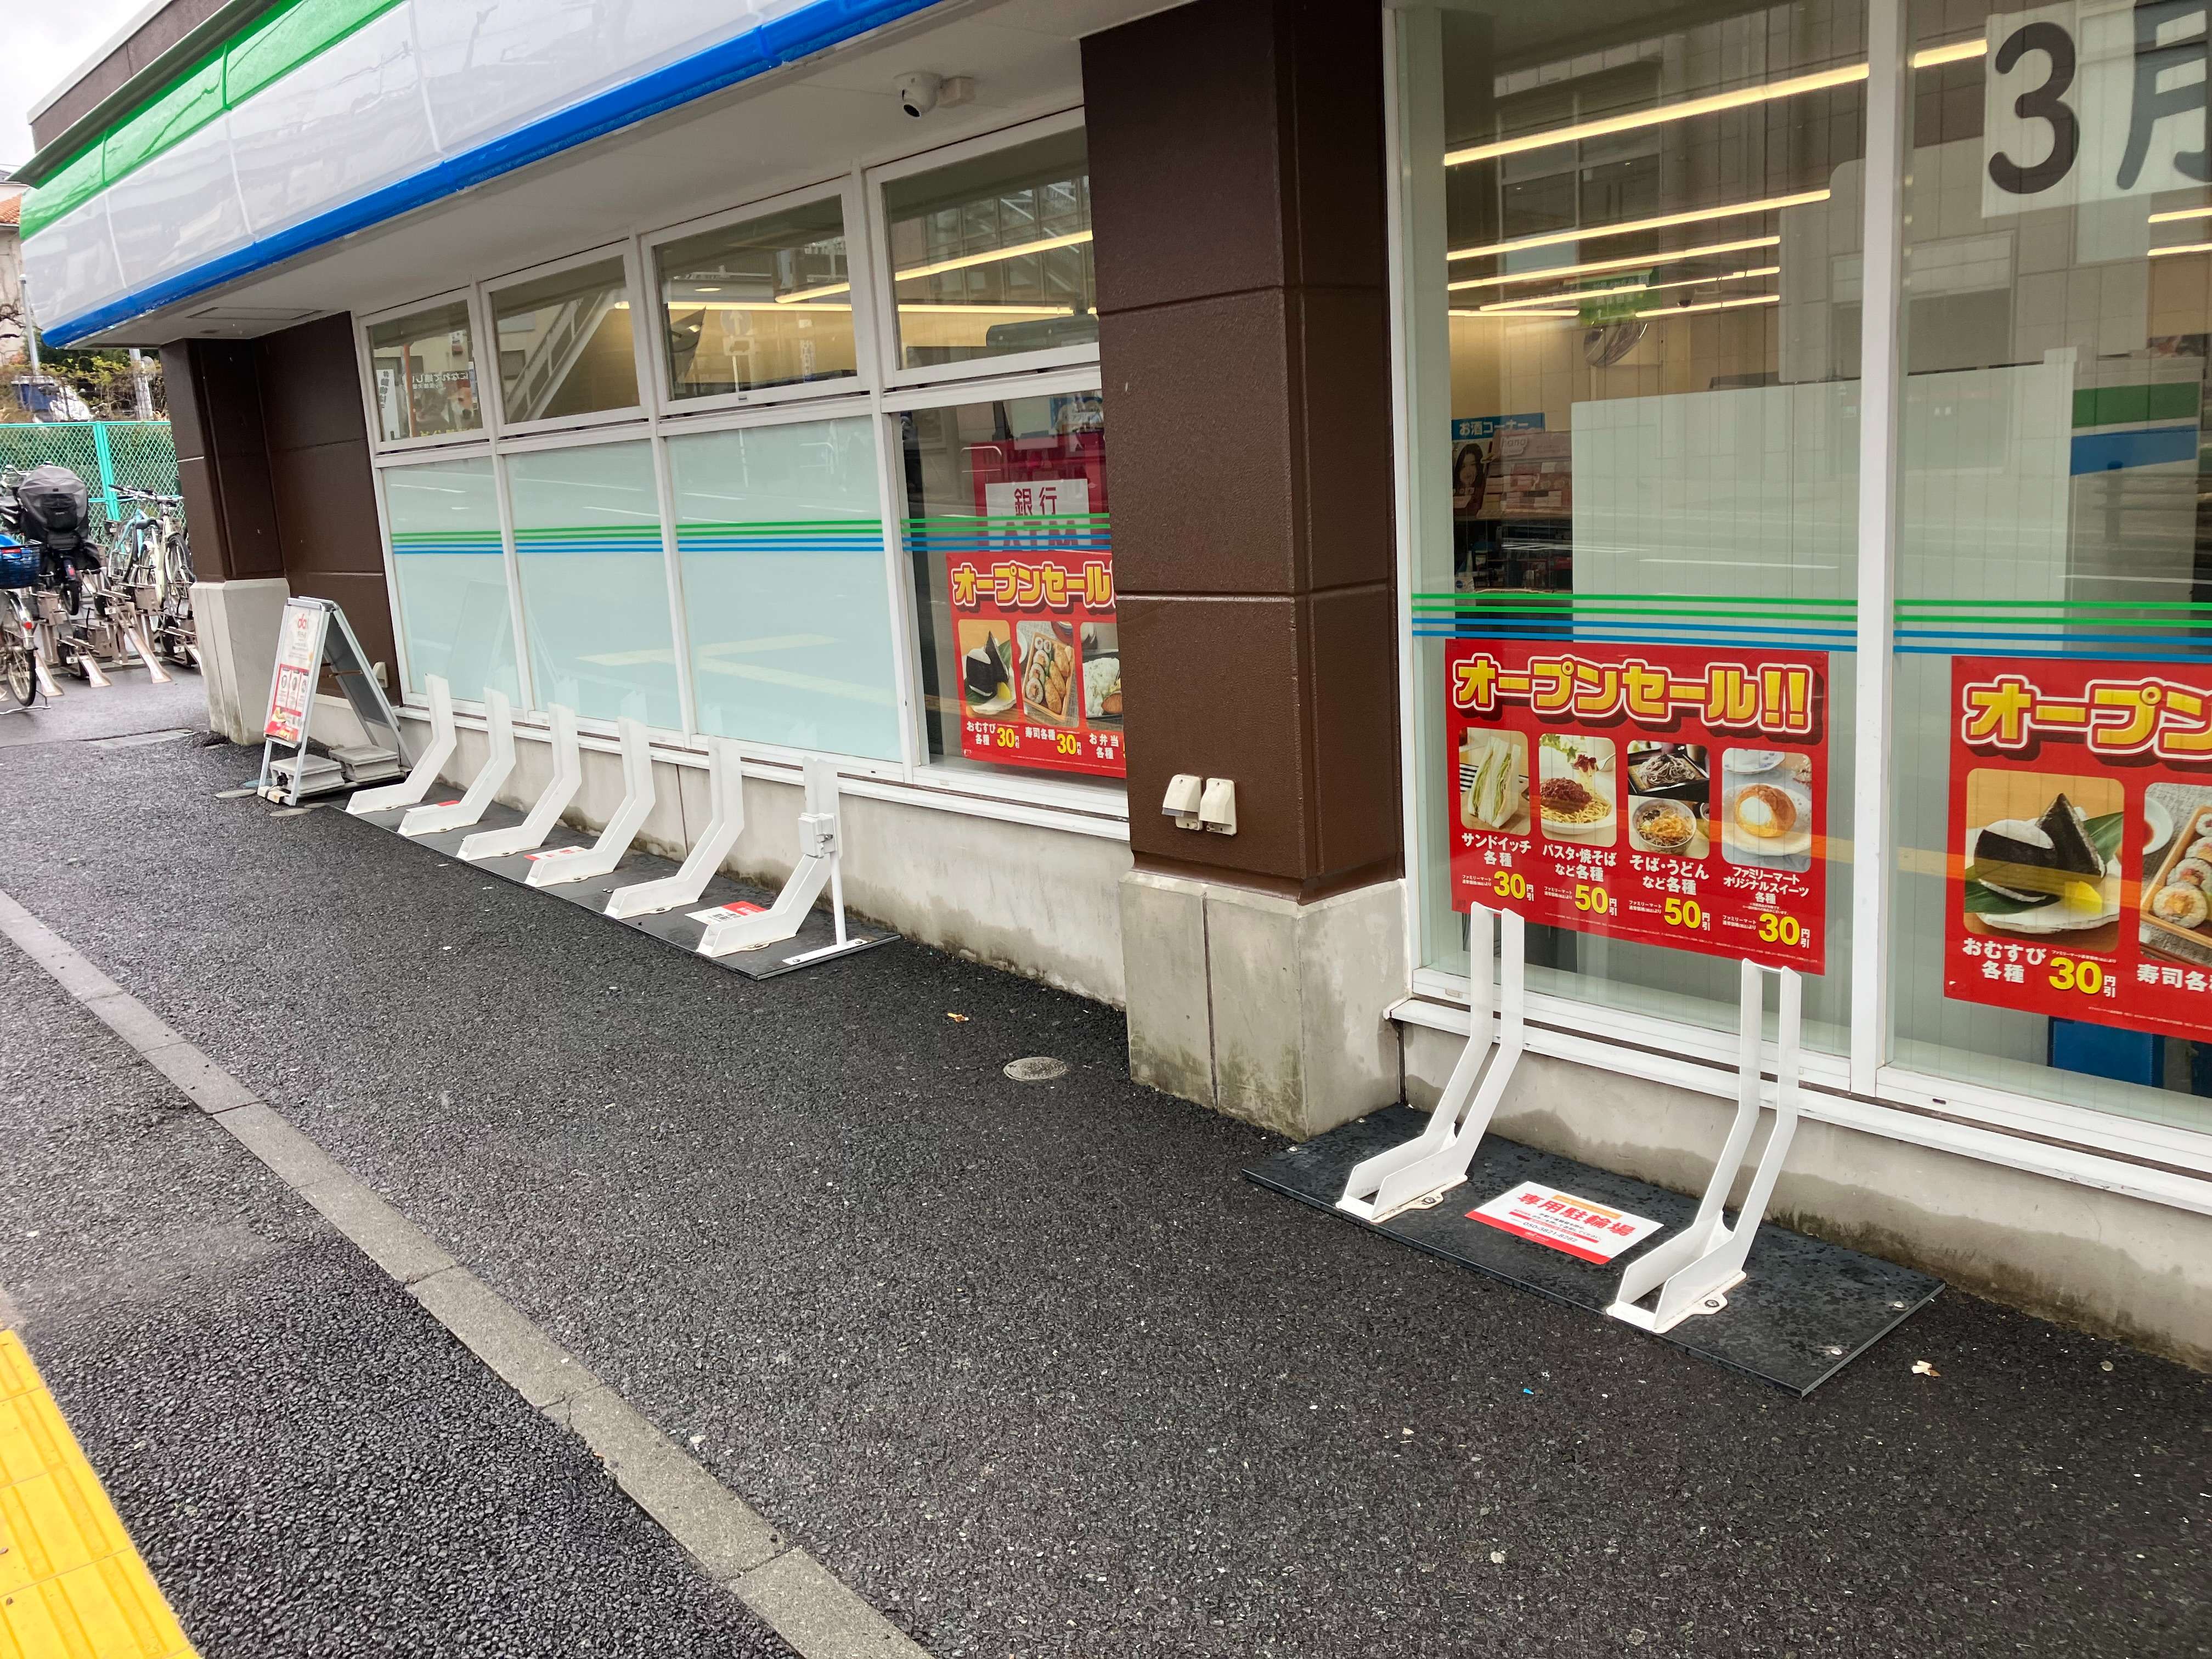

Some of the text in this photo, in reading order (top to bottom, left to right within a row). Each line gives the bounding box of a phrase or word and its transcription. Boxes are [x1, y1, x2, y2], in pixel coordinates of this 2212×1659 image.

[1459, 419, 1528, 436] お酒コーナー
[1014, 487, 1057, 516] 銀行
[1453, 653, 1814, 733] オープンセール!!
[967, 721, 996, 734] おむすび
[997, 727, 1015, 748] 30
[1025, 726, 1056, 741] 寿司各種
[975, 734, 990, 746] 各種
[1057, 733, 1076, 755] 30
[1089, 732, 1119, 747] お弁当
[1096, 746, 1114, 759] 各種
[1462, 833, 1532, 854] サンドイッチ
[1483, 850, 1513, 867] 各種
[1542, 844, 1617, 867] パスタ・焼そば
[1555, 863, 1604, 882] など各種
[1629, 855, 1709, 880] そば・うどん
[1733, 867, 1800, 885] ファミリーマート
[1494, 871, 1526, 899] 30
[1643, 876, 1697, 895] など各種
[1723, 876, 1809, 898] オリジナルスイーツ
[1575, 884, 1609, 914] 50
[1755, 891, 1777, 905] 各種
[1664, 897, 1701, 929] 50
[1758, 913, 1799, 946] 30
[1962, 937, 2046, 966] おむすび
[1982, 961, 2025, 984] 各種
[2049, 957, 2103, 994] 30
[2137, 964, 2212, 992] 寿司各
[1518, 1193, 1636, 1236] 専用駐輪場
